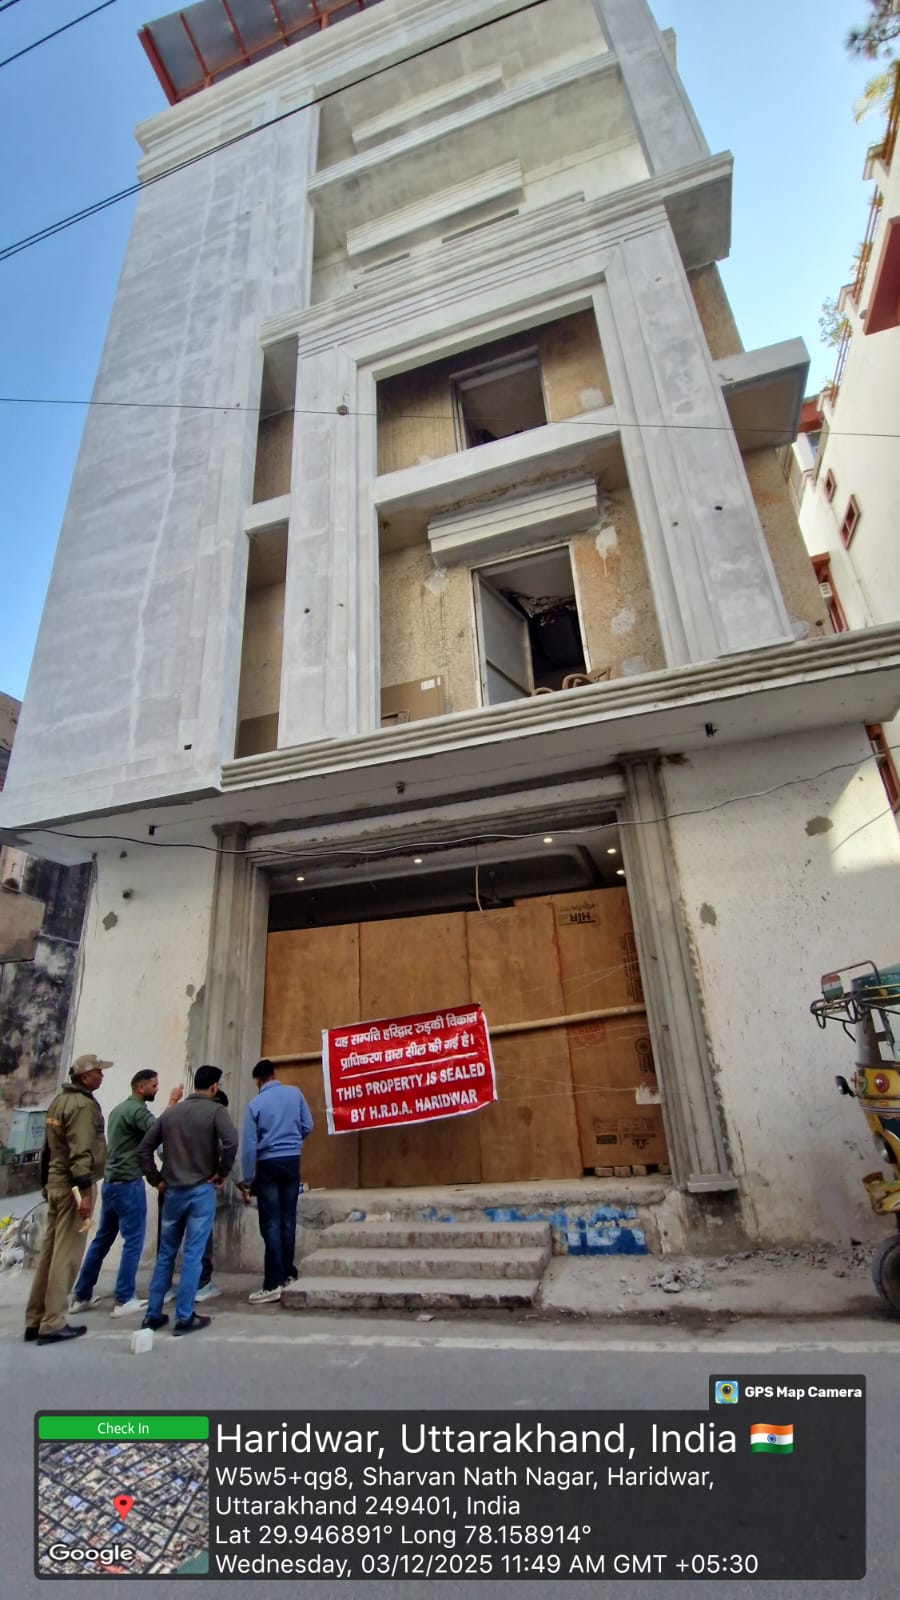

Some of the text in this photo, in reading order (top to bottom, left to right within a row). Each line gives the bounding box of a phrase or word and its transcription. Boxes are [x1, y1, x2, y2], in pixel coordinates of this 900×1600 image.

[334, 1035, 348, 1048] यह
[383, 1023, 413, 1041] हरिद्वार
[446, 1012, 478, 1028] विकास
[340, 1052, 383, 1072] प्राधिकरण
[384, 1048, 404, 1063] द्वारा
[405, 1042, 426, 1059] सील
[428, 1037, 442, 1053] की
[444, 1032, 459, 1050] गई
[336, 1062, 486, 1101] THIS PROPERTY IS SEALED
[350, 1088, 478, 1123] BY H.R.D.A. HARIDWAR
